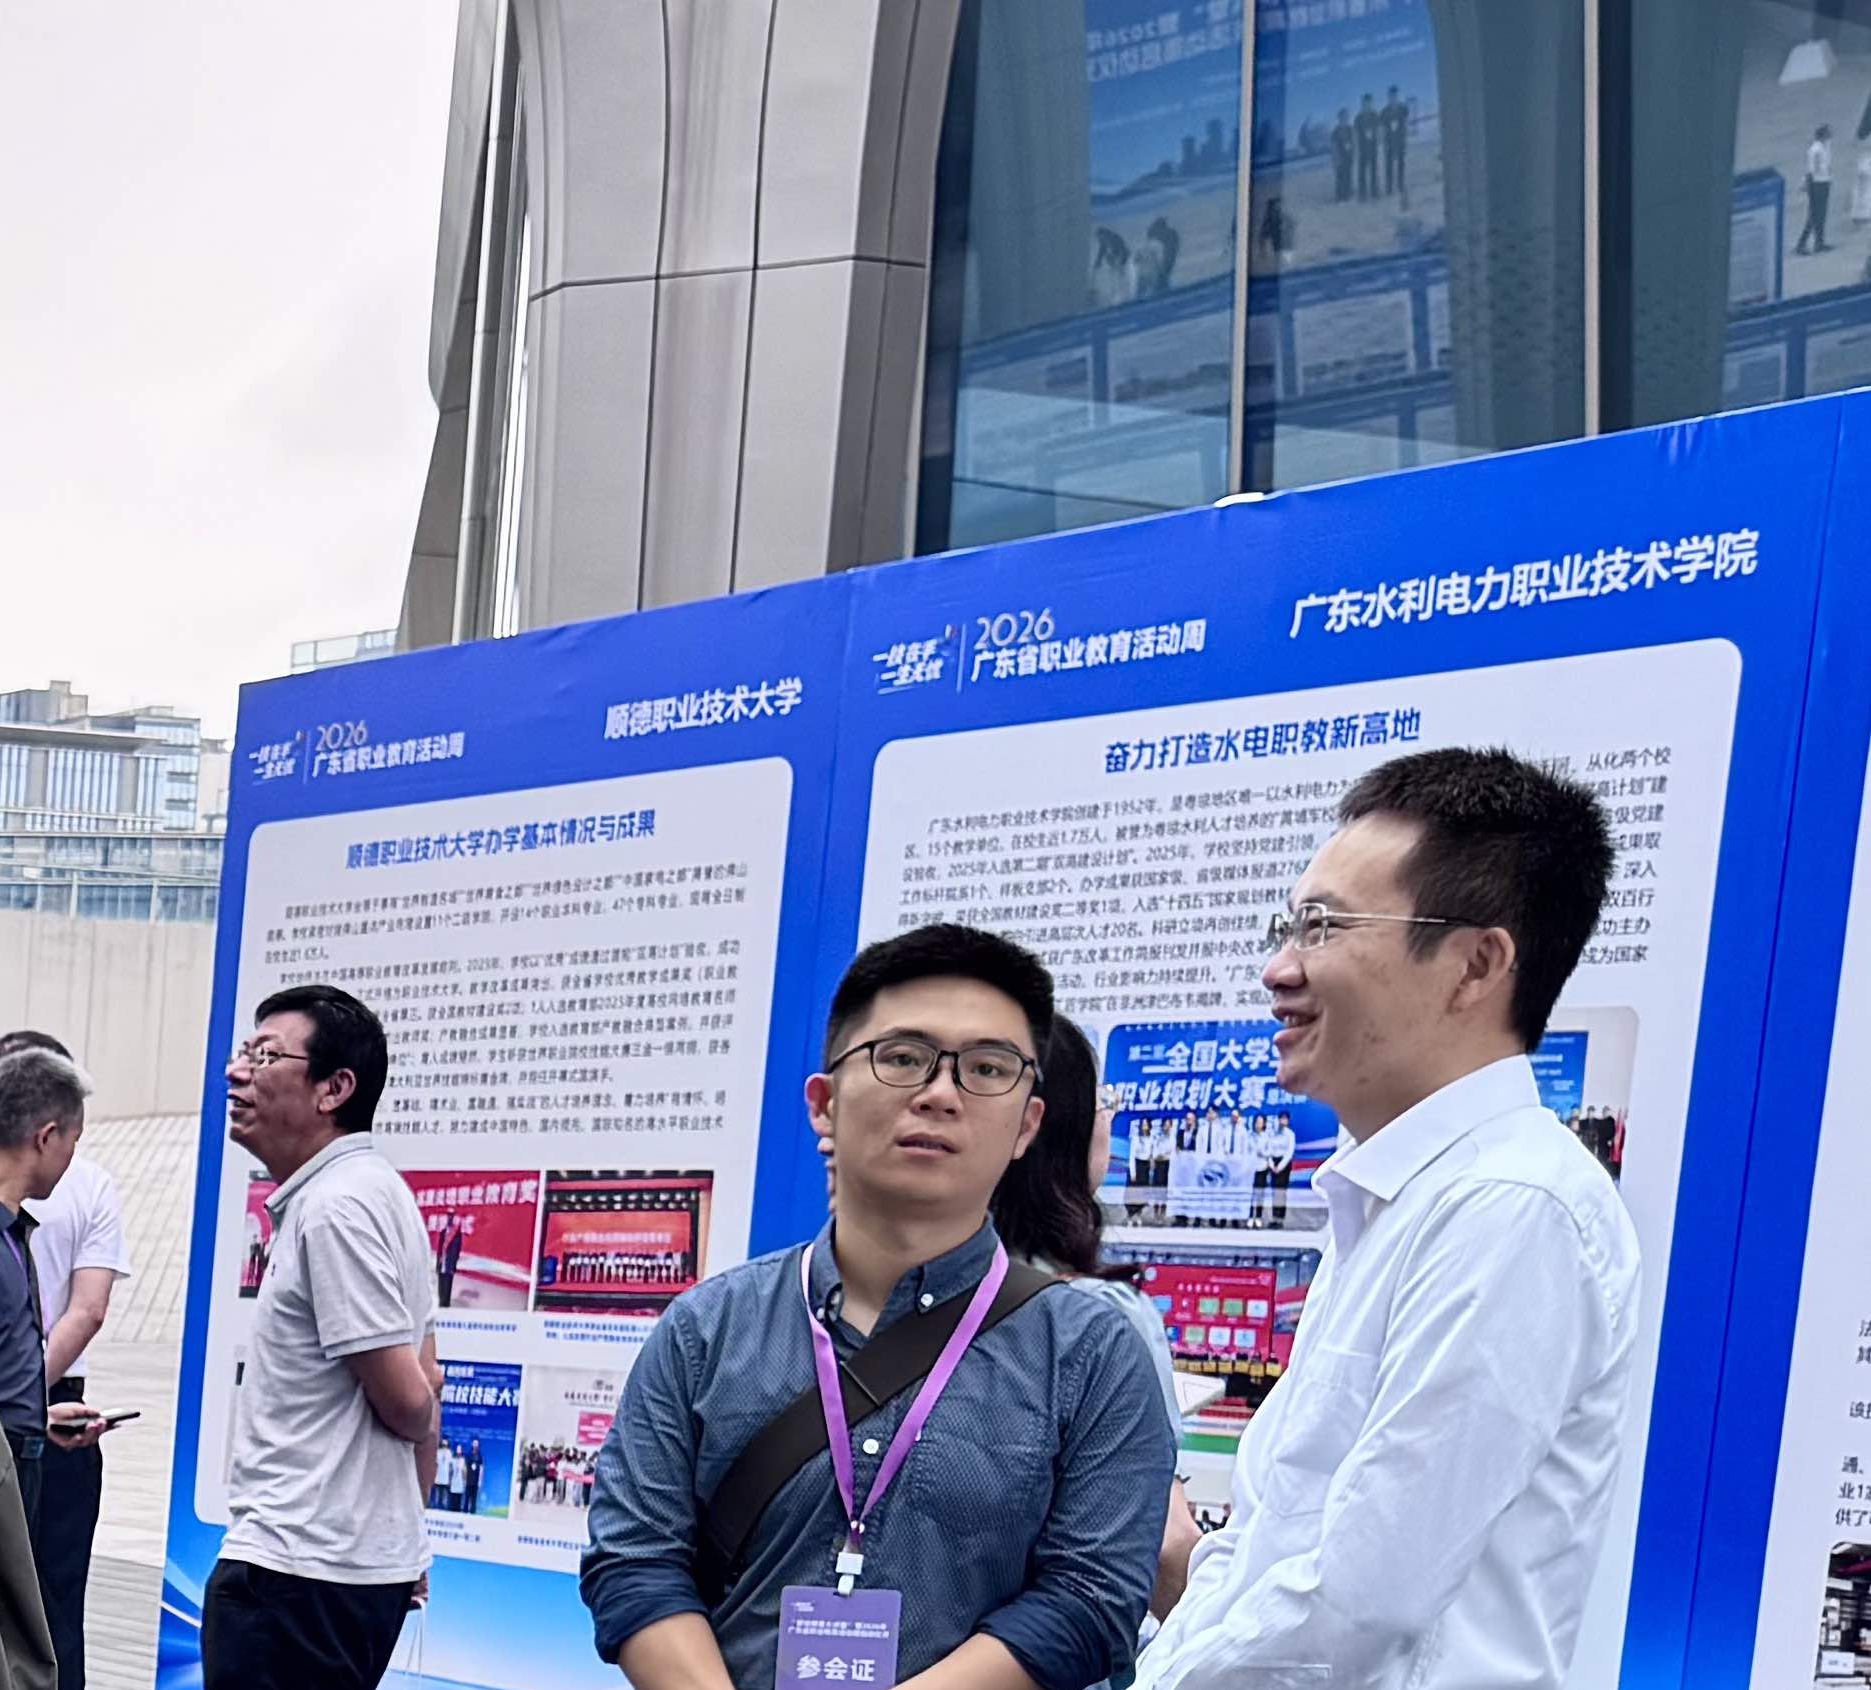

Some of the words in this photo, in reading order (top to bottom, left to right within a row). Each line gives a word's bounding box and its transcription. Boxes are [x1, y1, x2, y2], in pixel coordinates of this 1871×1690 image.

[1289, 528, 1759, 638] 广东水利电力职业技术学院
[970, 618, 1206, 683] 广东省职业教育活动周
[972, 607, 1056, 650] 2026
[314, 719, 368, 751] 2026
[604, 677, 803, 741] 顺德职业技术大学
[312, 731, 465, 778] 广东省职业教育活动周
[1105, 707, 1421, 774] 奋力打造水电职教新高地
[346, 808, 657, 870] 顺德职业技术大学办学基本情况与成果
[1114, 1075, 1265, 1111] 职业规划大赛
[796, 1654, 876, 1682] 参会证
